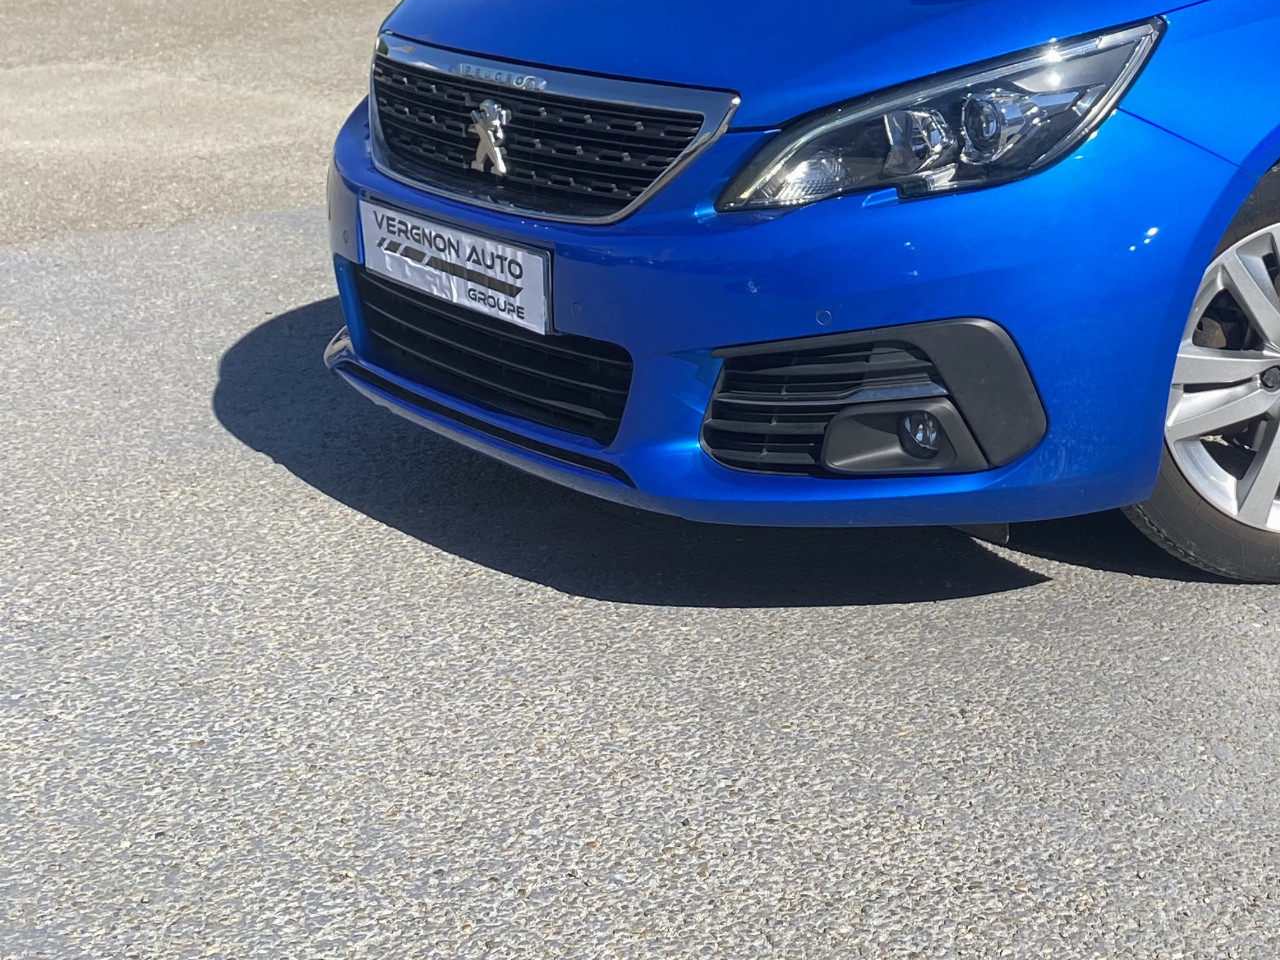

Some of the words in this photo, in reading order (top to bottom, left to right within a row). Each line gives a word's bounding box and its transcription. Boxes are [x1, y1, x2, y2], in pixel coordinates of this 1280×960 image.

[373, 210, 461, 258] VERGNON
[466, 245, 523, 280] AUTO
[467, 288, 525, 320] GROUPE
